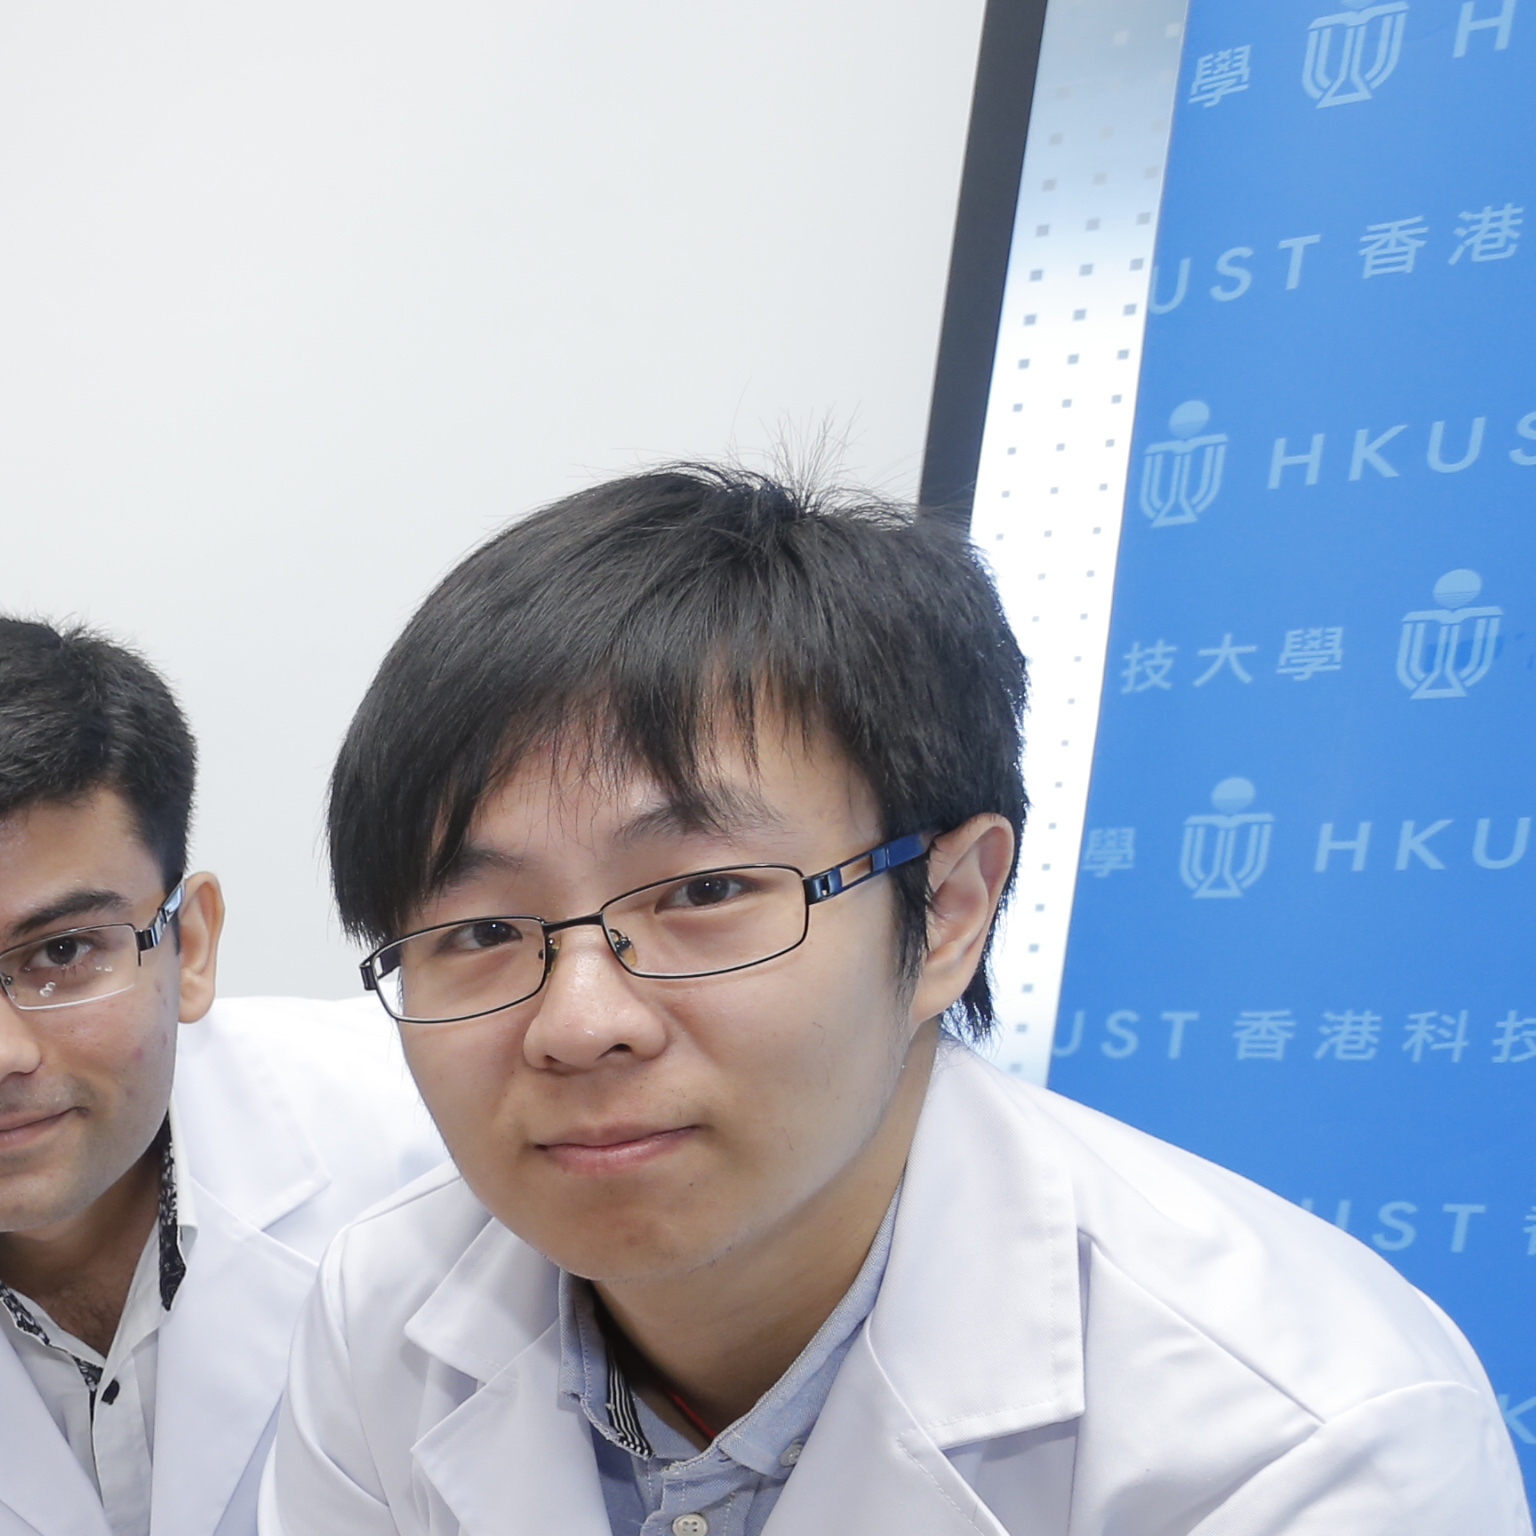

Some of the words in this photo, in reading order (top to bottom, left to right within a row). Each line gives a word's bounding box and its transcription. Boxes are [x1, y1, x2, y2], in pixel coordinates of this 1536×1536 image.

[1188, 44, 1252, 108] 學
[1149, 234, 1321, 315] UST
[1358, 203, 1523, 279] 香港
[1121, 626, 1344, 693] 技大學
[1083, 827, 1136, 877] 學
[1314, 817, 1531, 872] HKU
